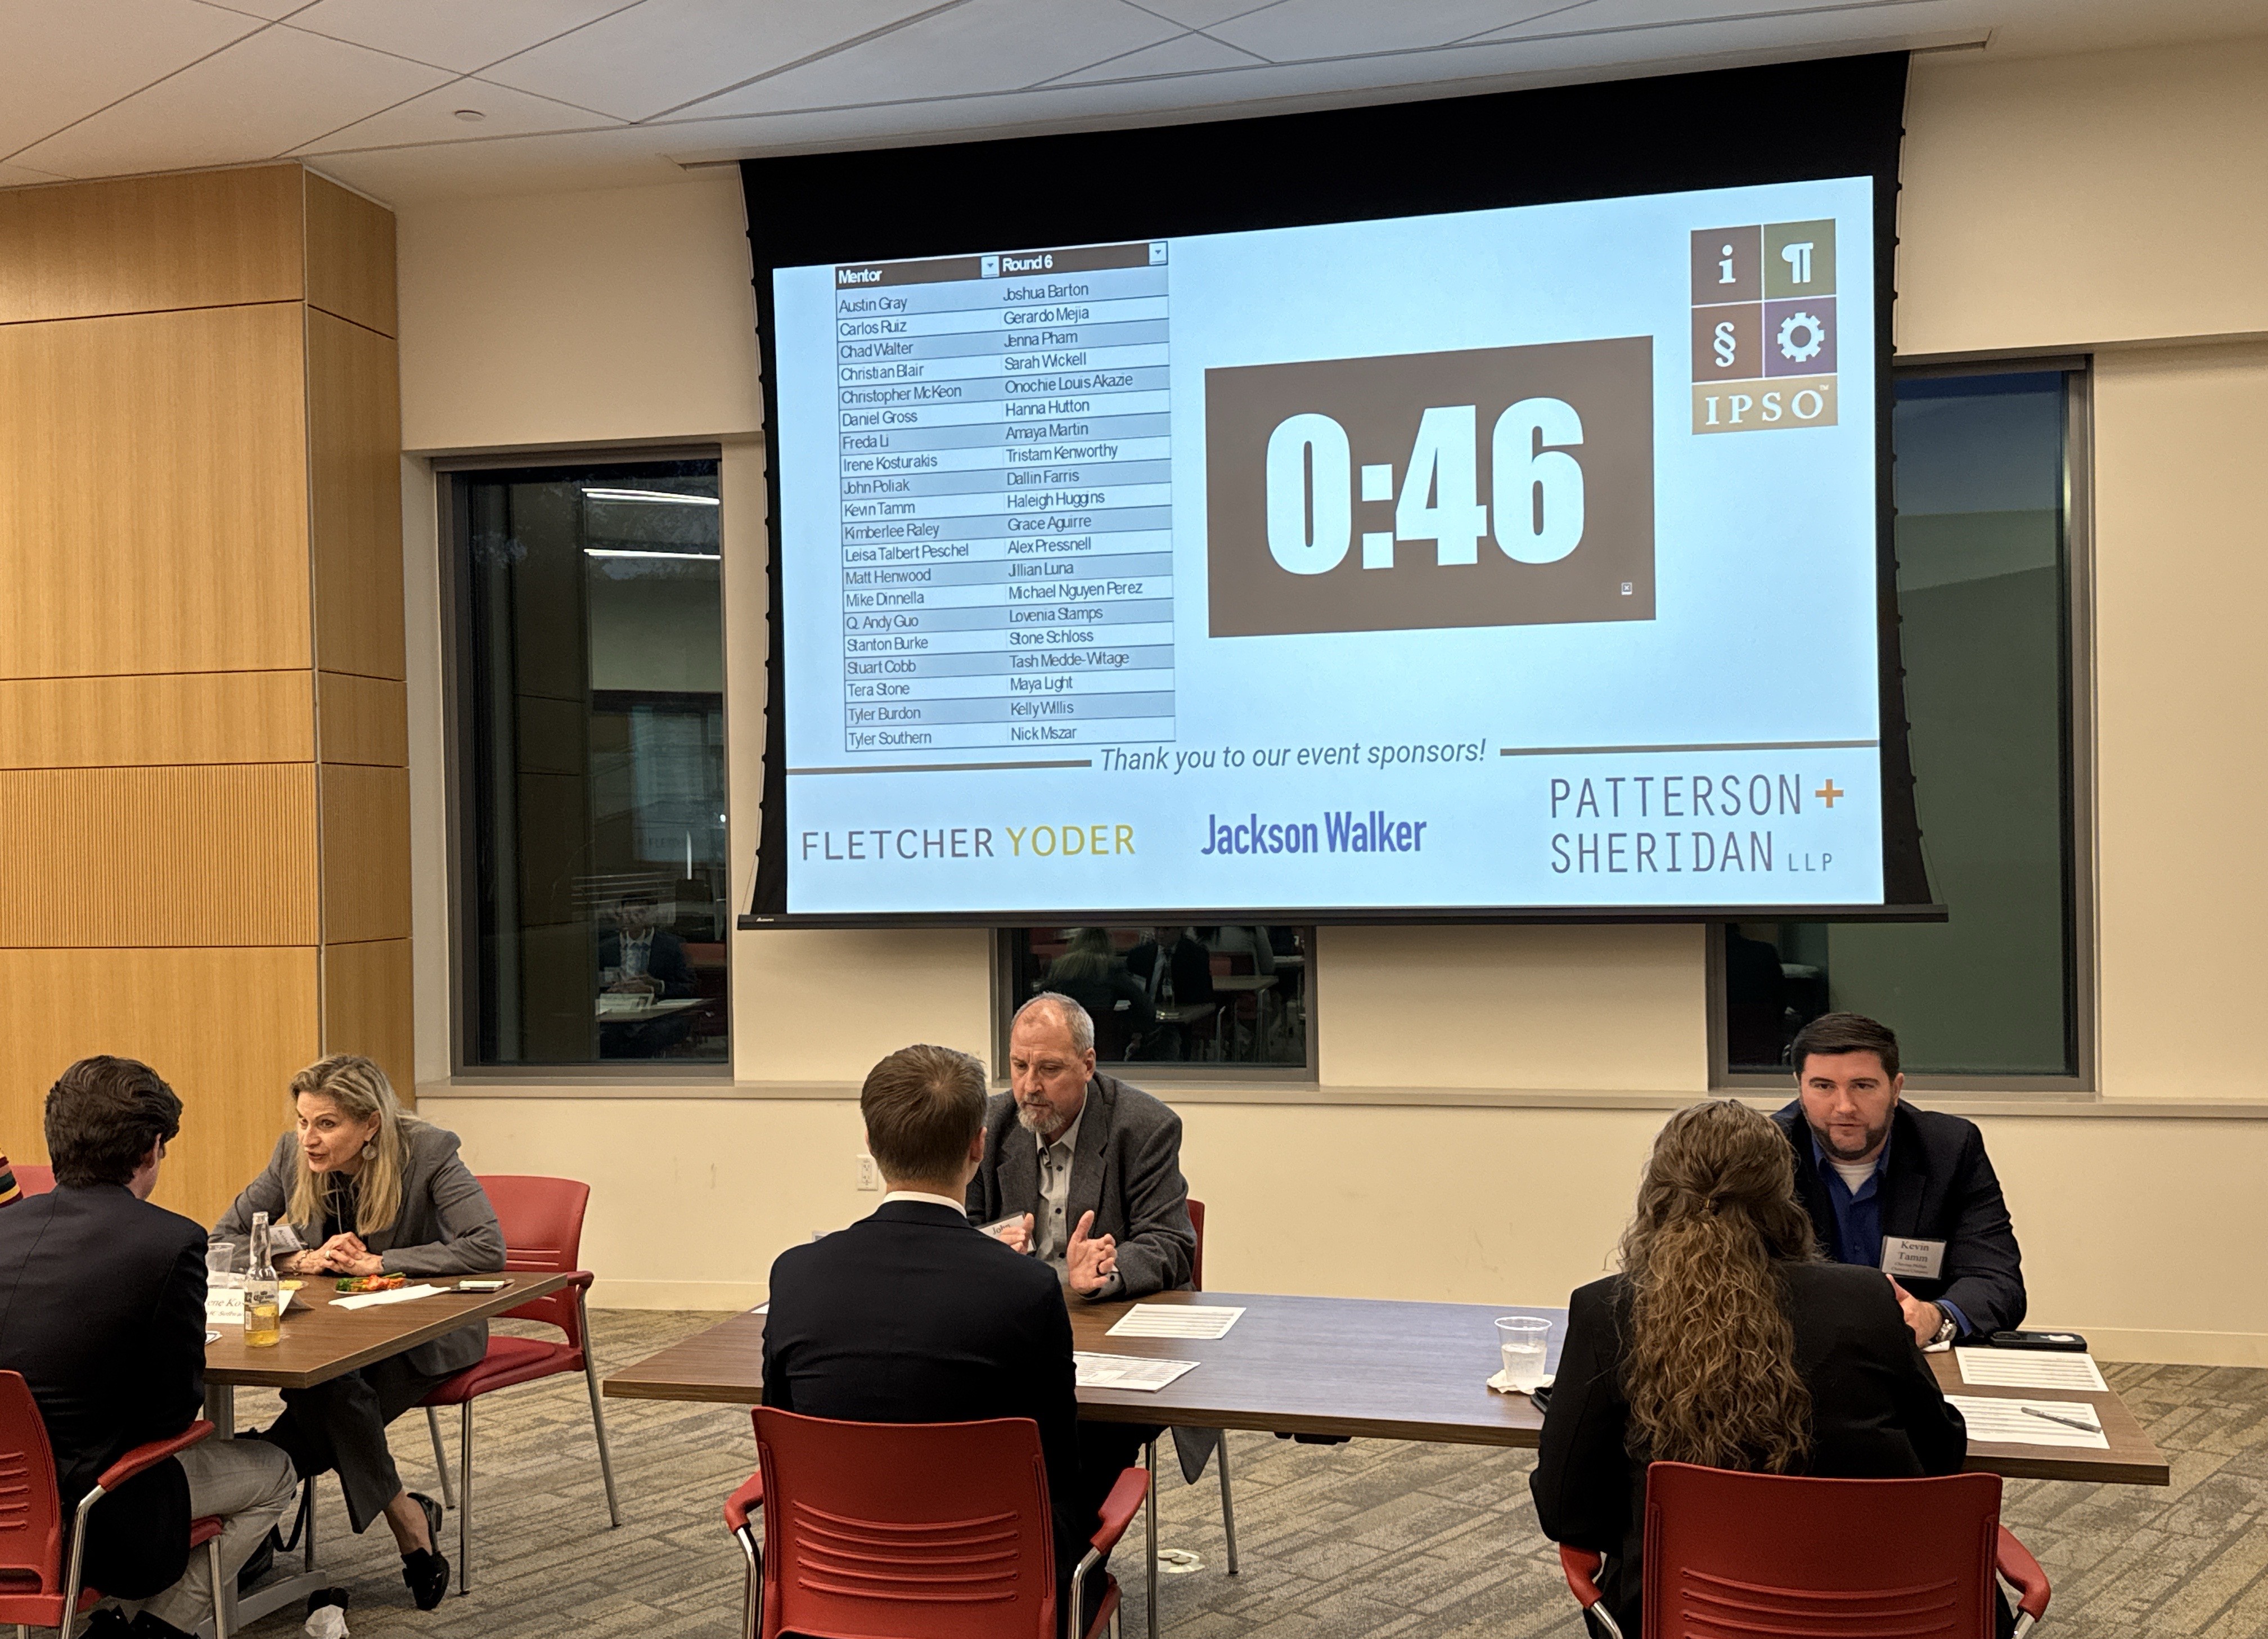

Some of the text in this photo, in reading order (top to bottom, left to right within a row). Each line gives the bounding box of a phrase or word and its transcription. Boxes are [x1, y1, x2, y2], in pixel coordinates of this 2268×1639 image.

[1002, 254, 1053, 272] Round 6
[839, 269, 882, 283] Mentor
[1003, 283, 1088, 301] Joshua Barton
[839, 297, 907, 313] Austin Gray
[1004, 305, 1089, 325] Gerardo Mejia
[840, 319, 907, 336] Carlos Ruiz
[1004, 331, 1078, 347] Jenna Pham
[840, 342, 914, 358] Chad Walter
[1005, 352, 1086, 370] Sarah Wickell
[842, 363, 924, 381] Christian Blair
[1005, 372, 1133, 393] Onochie Louis Akazie
[842, 385, 962, 405] Christopher McKeon
[1006, 399, 1090, 416] Hanna Hutton
[1706, 390, 1823, 425] IPSO
[843, 411, 917, 426] Daniel Gross
[1006, 422, 1088, 442] Amaya Martin
[843, 434, 889, 449] Freda Li
[1006, 443, 1118, 462] Tristam Kenworthy
[844, 454, 938, 472] Irene Kosturakis
[1007, 469, 1079, 485] Dallin Farris
[844, 479, 910, 494] John Poliak
[1266, 397, 1585, 575] 0:46
[1007, 490, 1105, 510] Haleigh Huggins
[845, 502, 915, 517] Kevin Tamm
[845, 523, 939, 539] Kimberlee Raley
[1008, 515, 1091, 532] Grace Aguirre
[846, 543, 969, 562] Leisa Talbert Peschel
[1008, 536, 1091, 553] Alex Pressnell
[846, 568, 931, 584] Matt Henwood
[1045, 562, 1074, 575] Luna
[847, 591, 924, 607] Mike Dinnella
[1009, 582, 1142, 600] Michael Nguyen Perez
[863, 615, 892, 632] Andy
[894, 615, 919, 628] Guo
[1010, 607, 1103, 623] Lovenia Stamps
[847, 636, 928, 651] Stanton Burke
[1010, 630, 1094, 645] Stone Schloss
[847, 659, 916, 674] Stuart Cobb
[1010, 655, 1038, 668] Tash
[847, 683, 910, 696] Tera Stone
[1011, 676, 1073, 694] Maya Light
[848, 706, 921, 724] Tyler Burdon
[1011, 701, 1074, 718] Kelly Willis
[848, 731, 932, 749] Tyler Southern
[1011, 727, 1039, 741] Nick
[1101, 739, 1486, 775] Thank you to our event sponsors!
[1551, 774, 1802, 818] PATTERSON
[1200, 811, 1427, 855] Jackson Walker
[802, 824, 1136, 861] FLETCHER YODER
[1551, 831, 1833, 874] SHERIDAN LLP
[1900, 1241, 1929, 1250] Kevin
[1899, 1251, 1928, 1263] Tamm
